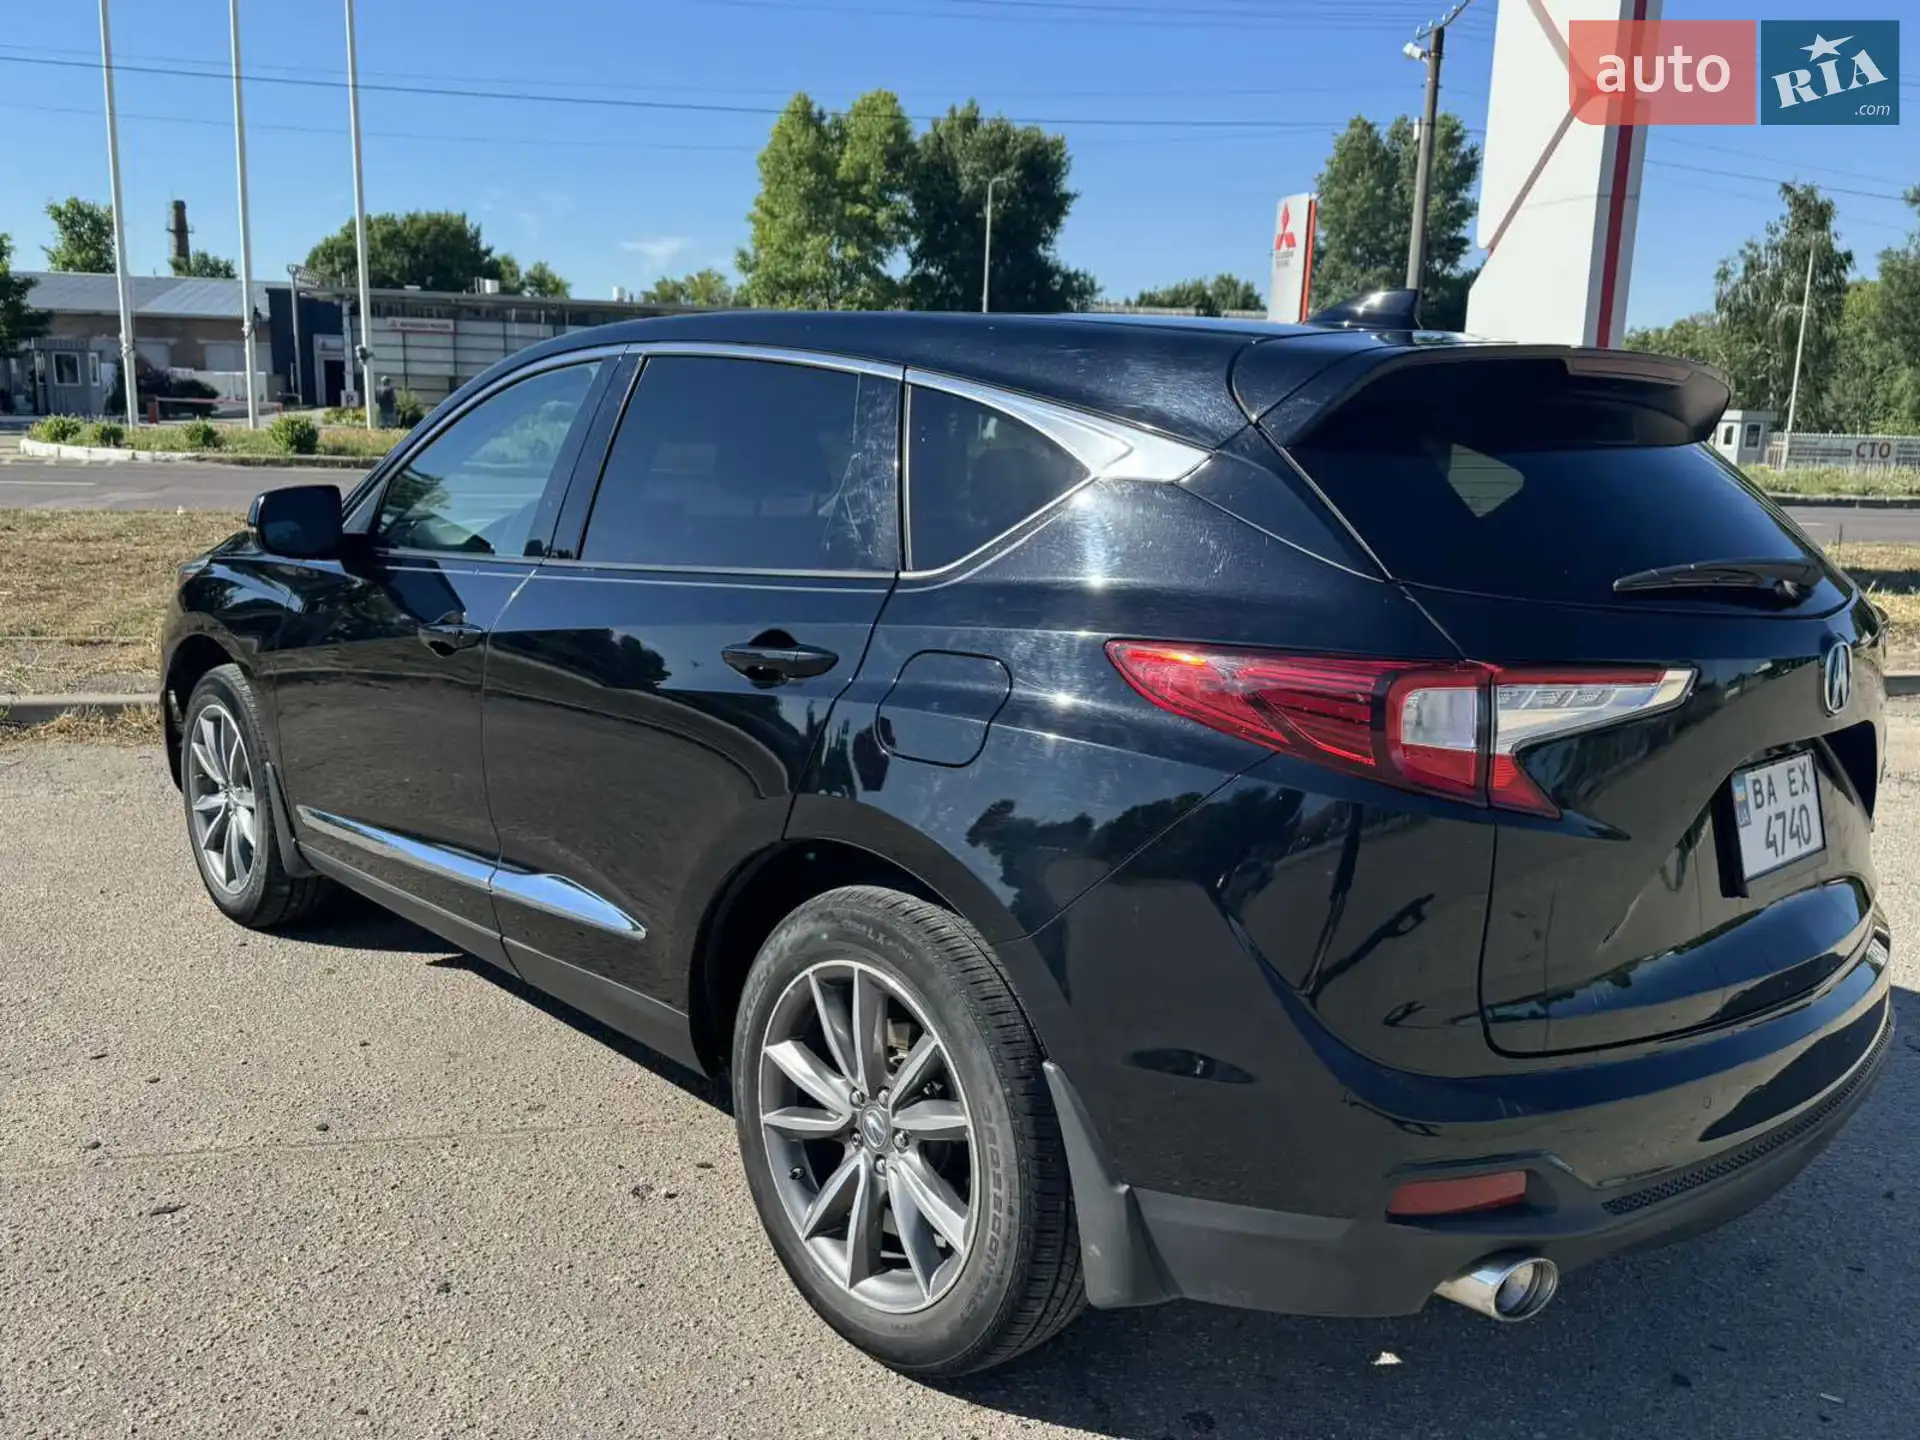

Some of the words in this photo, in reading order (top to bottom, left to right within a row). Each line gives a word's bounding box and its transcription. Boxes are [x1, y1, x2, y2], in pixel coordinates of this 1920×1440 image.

[1751, 774, 1778, 810] BA
[1787, 762, 1811, 798] EX
[1765, 804, 1812, 858] 4740
